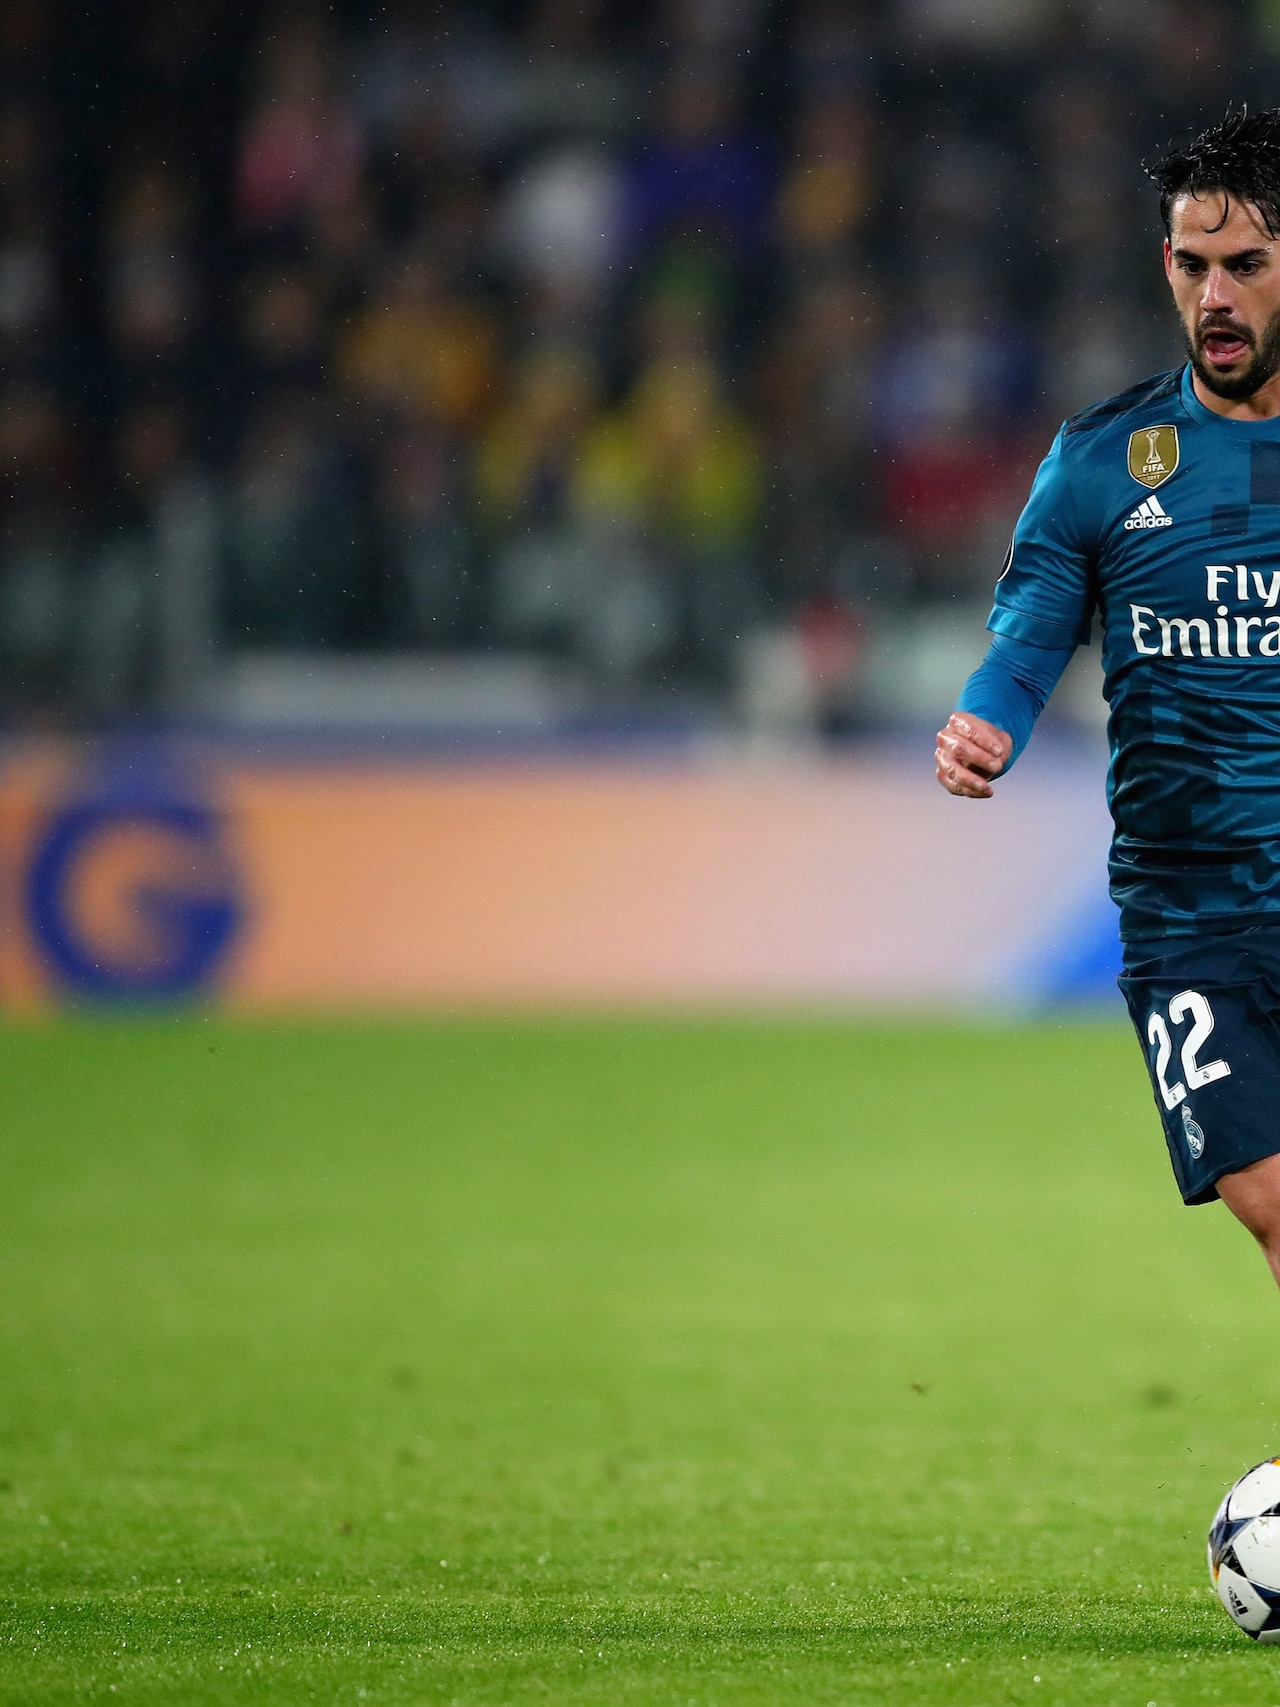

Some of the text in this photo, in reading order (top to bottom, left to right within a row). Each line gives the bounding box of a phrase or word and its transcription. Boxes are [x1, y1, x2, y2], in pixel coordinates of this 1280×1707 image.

[1142, 463, 1165, 473] FIFA
[1124, 516, 1173, 530] adidas
[1148, 989, 1232, 1111] 22
